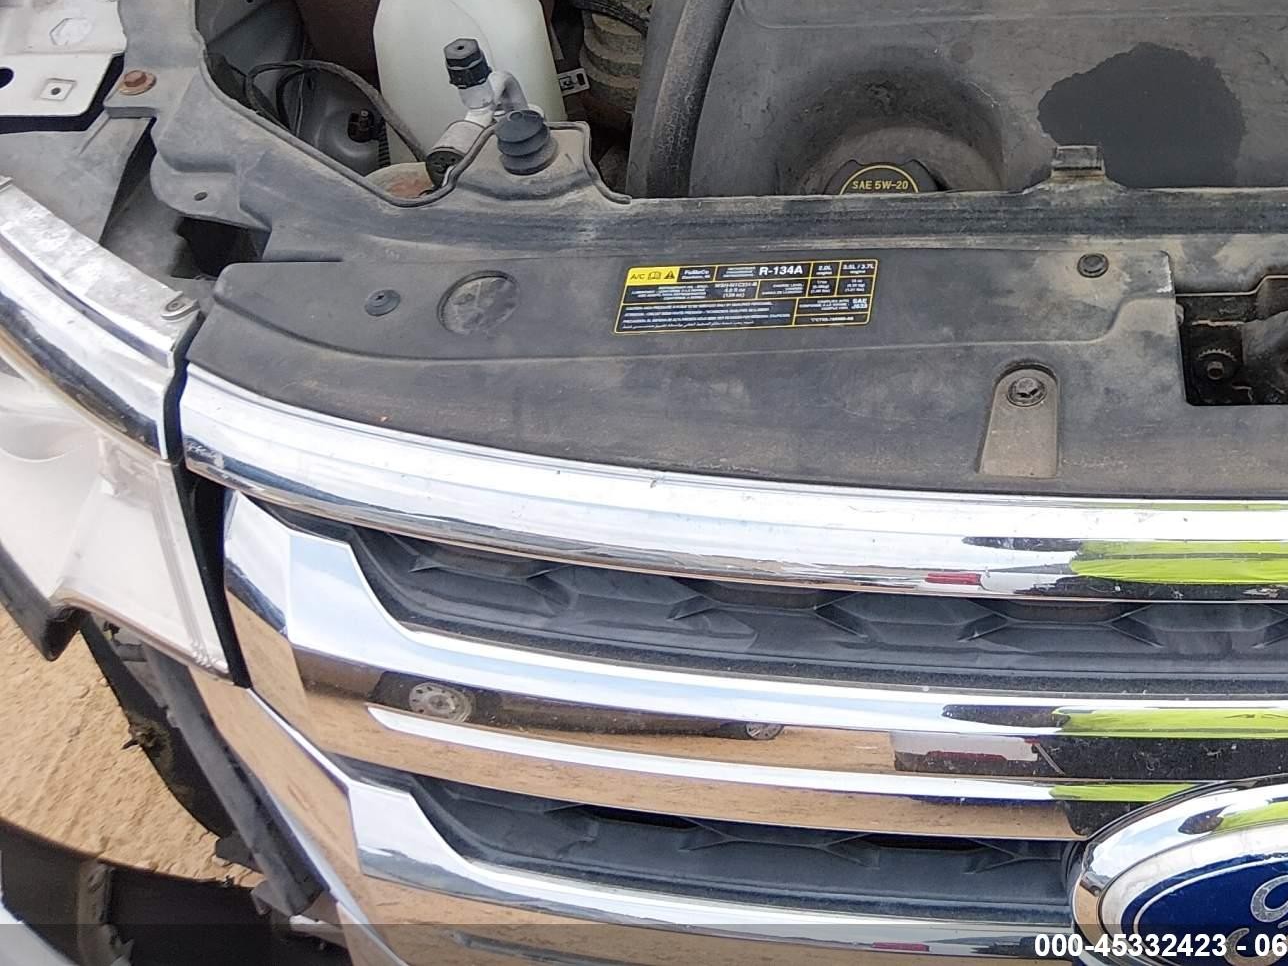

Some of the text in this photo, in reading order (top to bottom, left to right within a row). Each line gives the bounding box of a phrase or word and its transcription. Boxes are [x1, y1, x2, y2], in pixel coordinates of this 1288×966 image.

[852, 180, 909, 190] SAE 5W-20
[758, 265, 803, 276] R-134A
